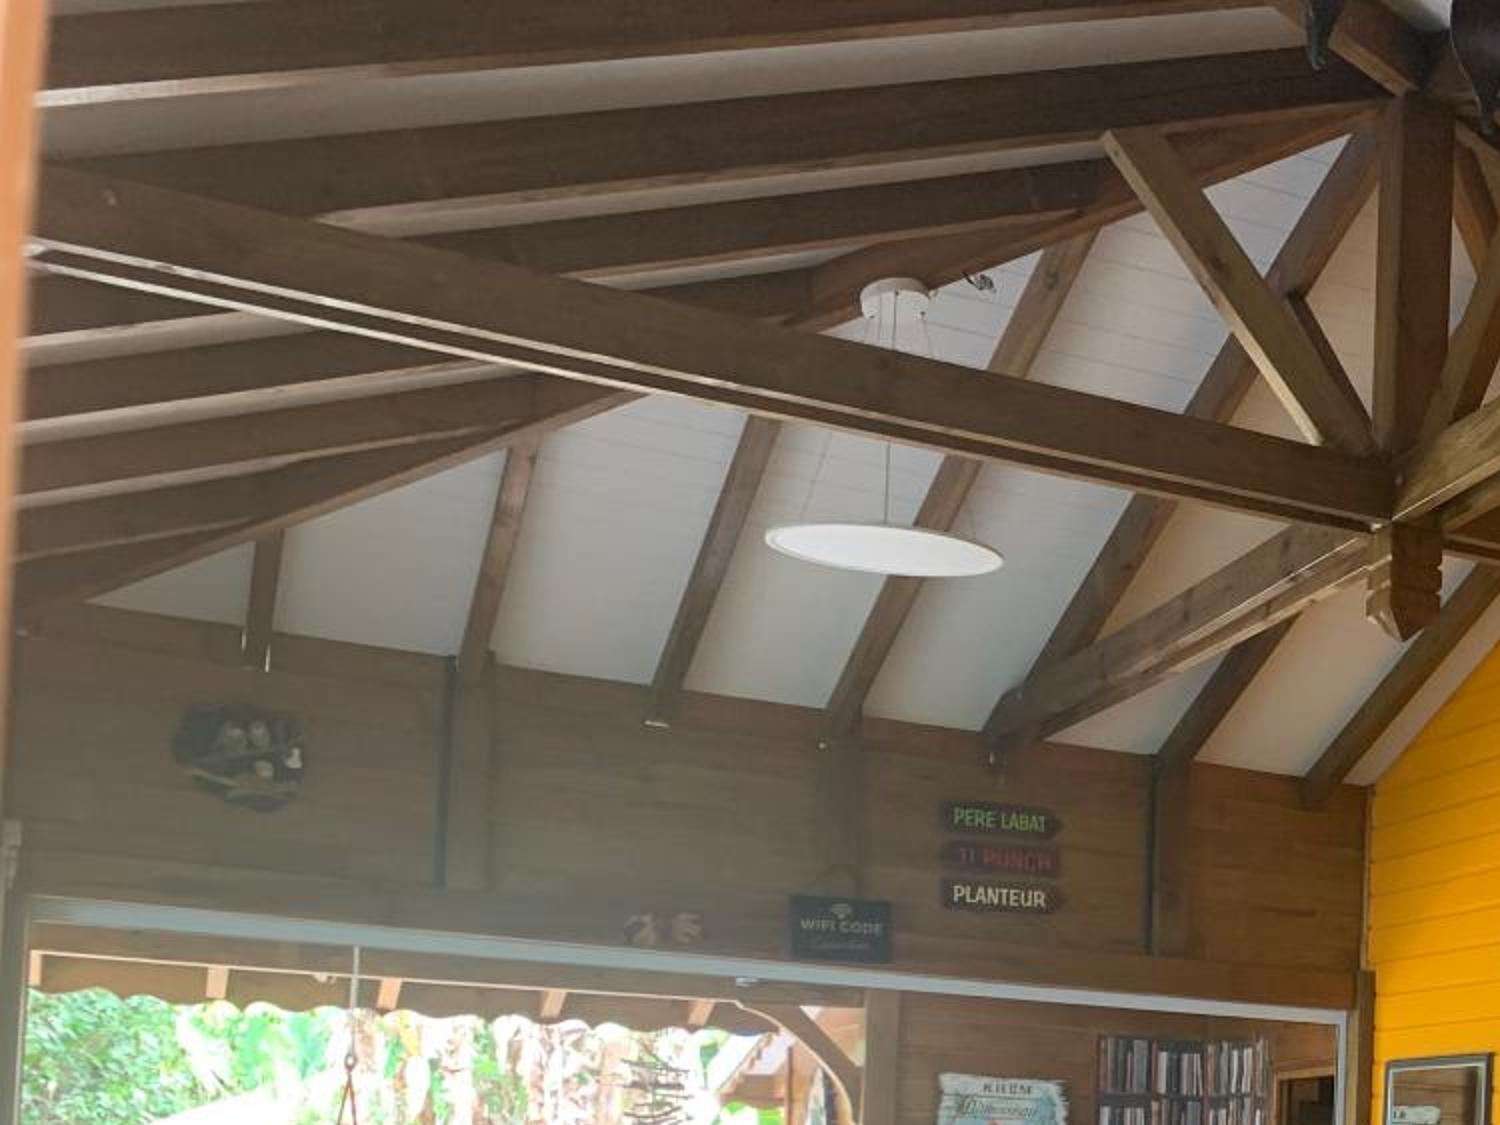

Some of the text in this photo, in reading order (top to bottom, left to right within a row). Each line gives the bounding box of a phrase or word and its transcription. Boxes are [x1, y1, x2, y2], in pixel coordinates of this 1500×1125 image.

[953, 807, 1046, 833] PERE LABAT
[953, 884, 1047, 910] PLANTEUR
[800, 918, 884, 936] WIFI CODE
